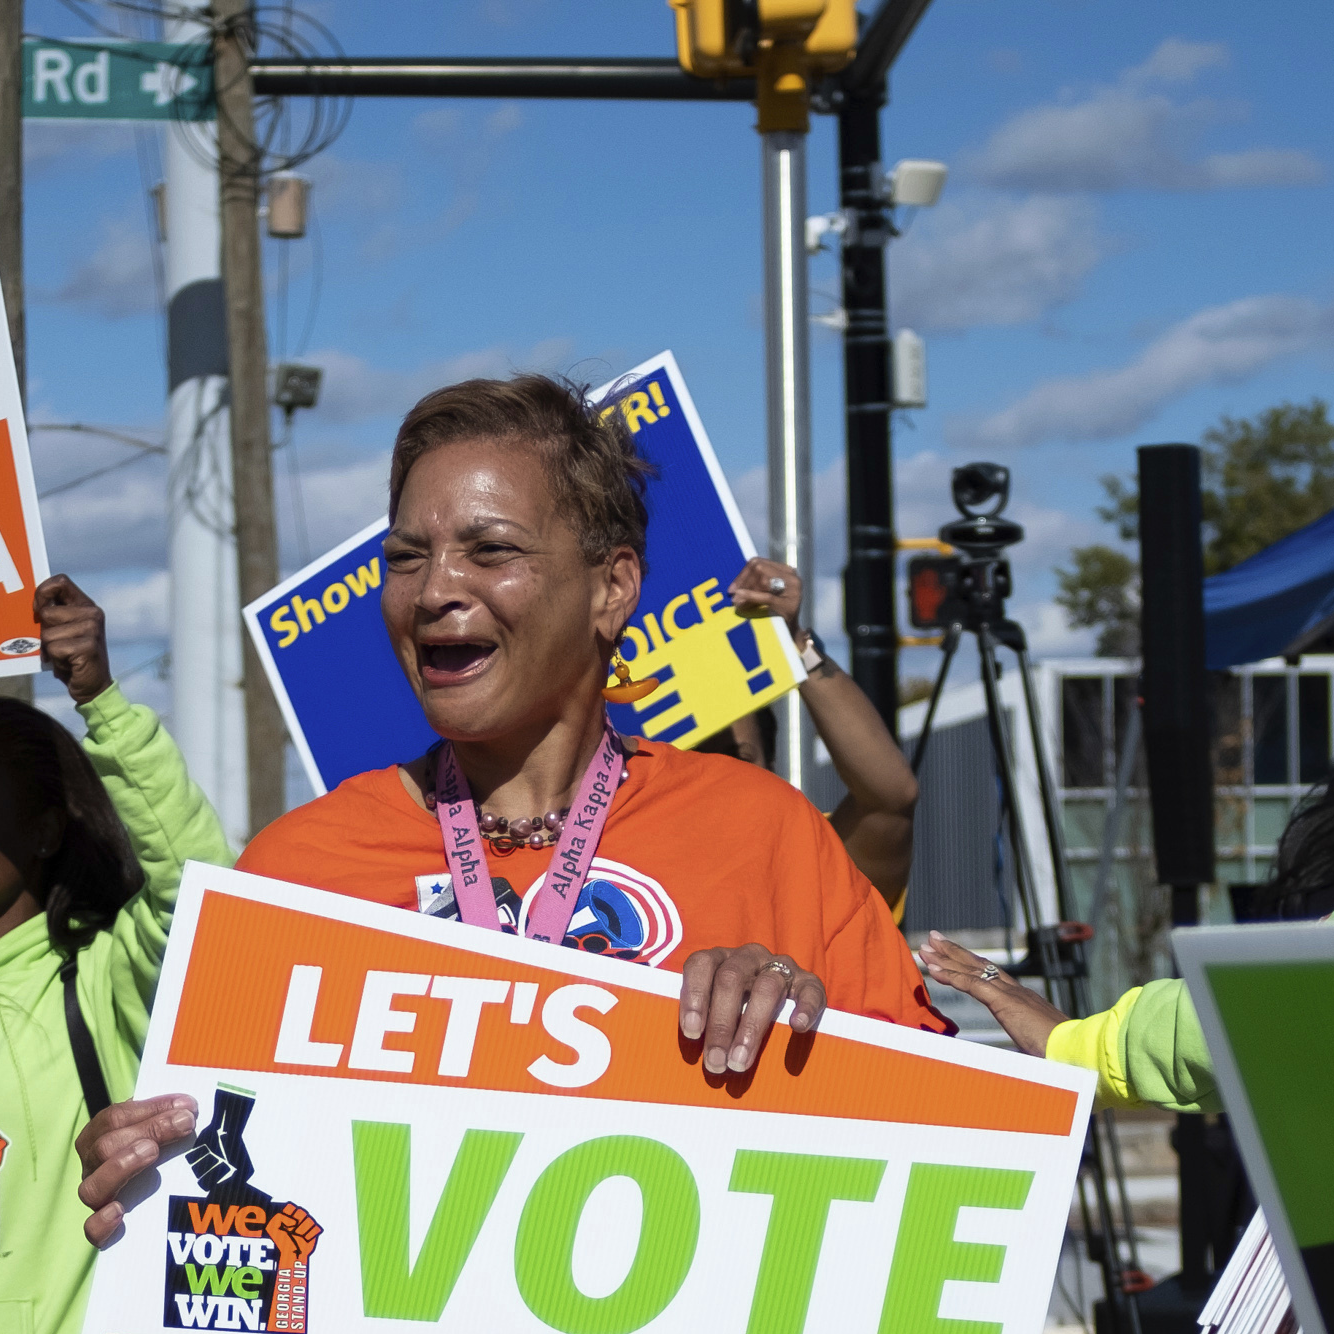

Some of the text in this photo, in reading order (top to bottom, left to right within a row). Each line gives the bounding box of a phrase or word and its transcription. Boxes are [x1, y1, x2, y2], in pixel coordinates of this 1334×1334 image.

[34, 48, 110, 105] Rd
[269, 557, 381, 648] Show
[451, 825, 481, 887] Alpha
[551, 836, 587, 900] Alpha
[573, 770, 612, 831] Kappa
[272, 963, 619, 1089] LET'S
[187, 1202, 267, 1237] we
[184, 1263, 264, 1299] we
[276, 1268, 291, 1329] GEORGIA
